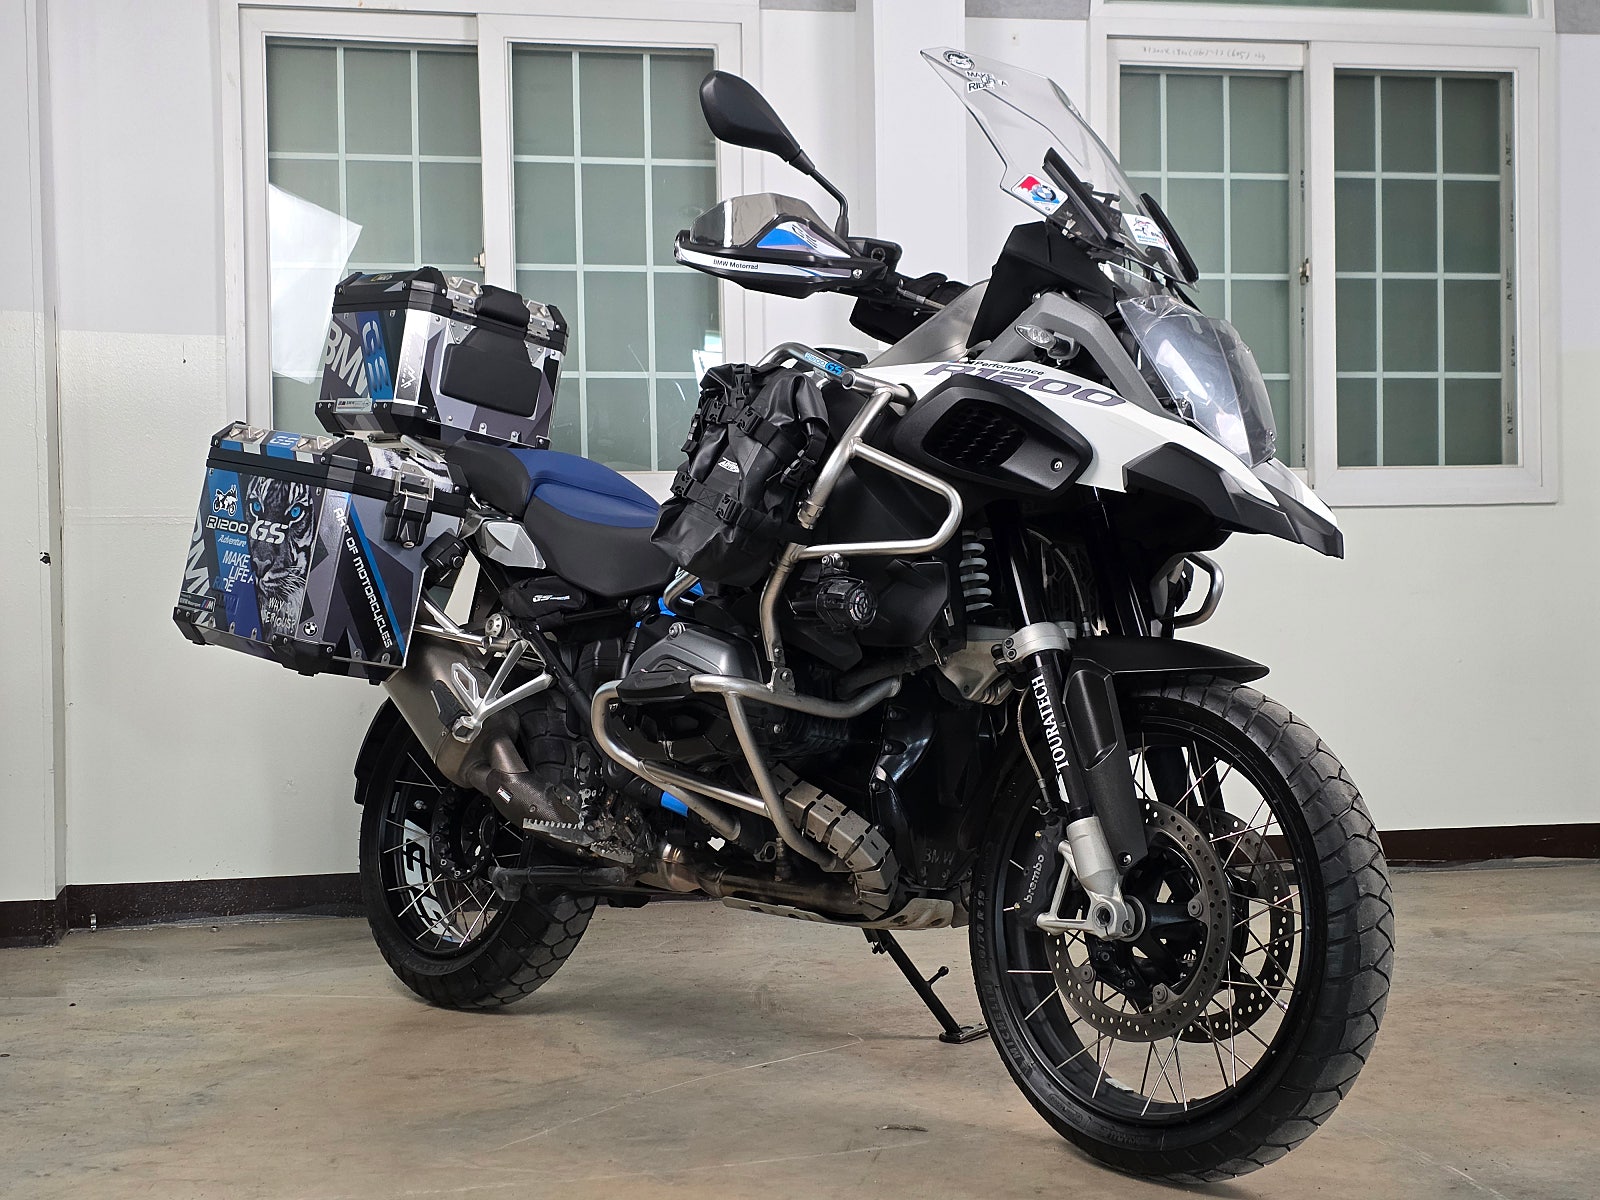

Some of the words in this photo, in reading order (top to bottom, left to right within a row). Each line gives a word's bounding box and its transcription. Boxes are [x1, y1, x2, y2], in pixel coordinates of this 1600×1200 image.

[729, 262, 759, 271] Motorrad
[974, 361, 1045, 376] Performance
[924, 363, 1127, 407] R1200
[206, 515, 249, 535] R1200
[250, 519, 289, 545] GS
[217, 534, 247, 548] Adventure
[223, 550, 250, 568] MAKE
[228, 565, 250, 584] LIFE
[333, 507, 351, 535] ART
[345, 537, 359, 556] OF
[352, 556, 393, 650] MOTORCYCLES
[268, 596, 285, 613] WHY
[1031, 673, 1070, 774] TOURATECH
[1023, 854, 1045, 904] brembo
